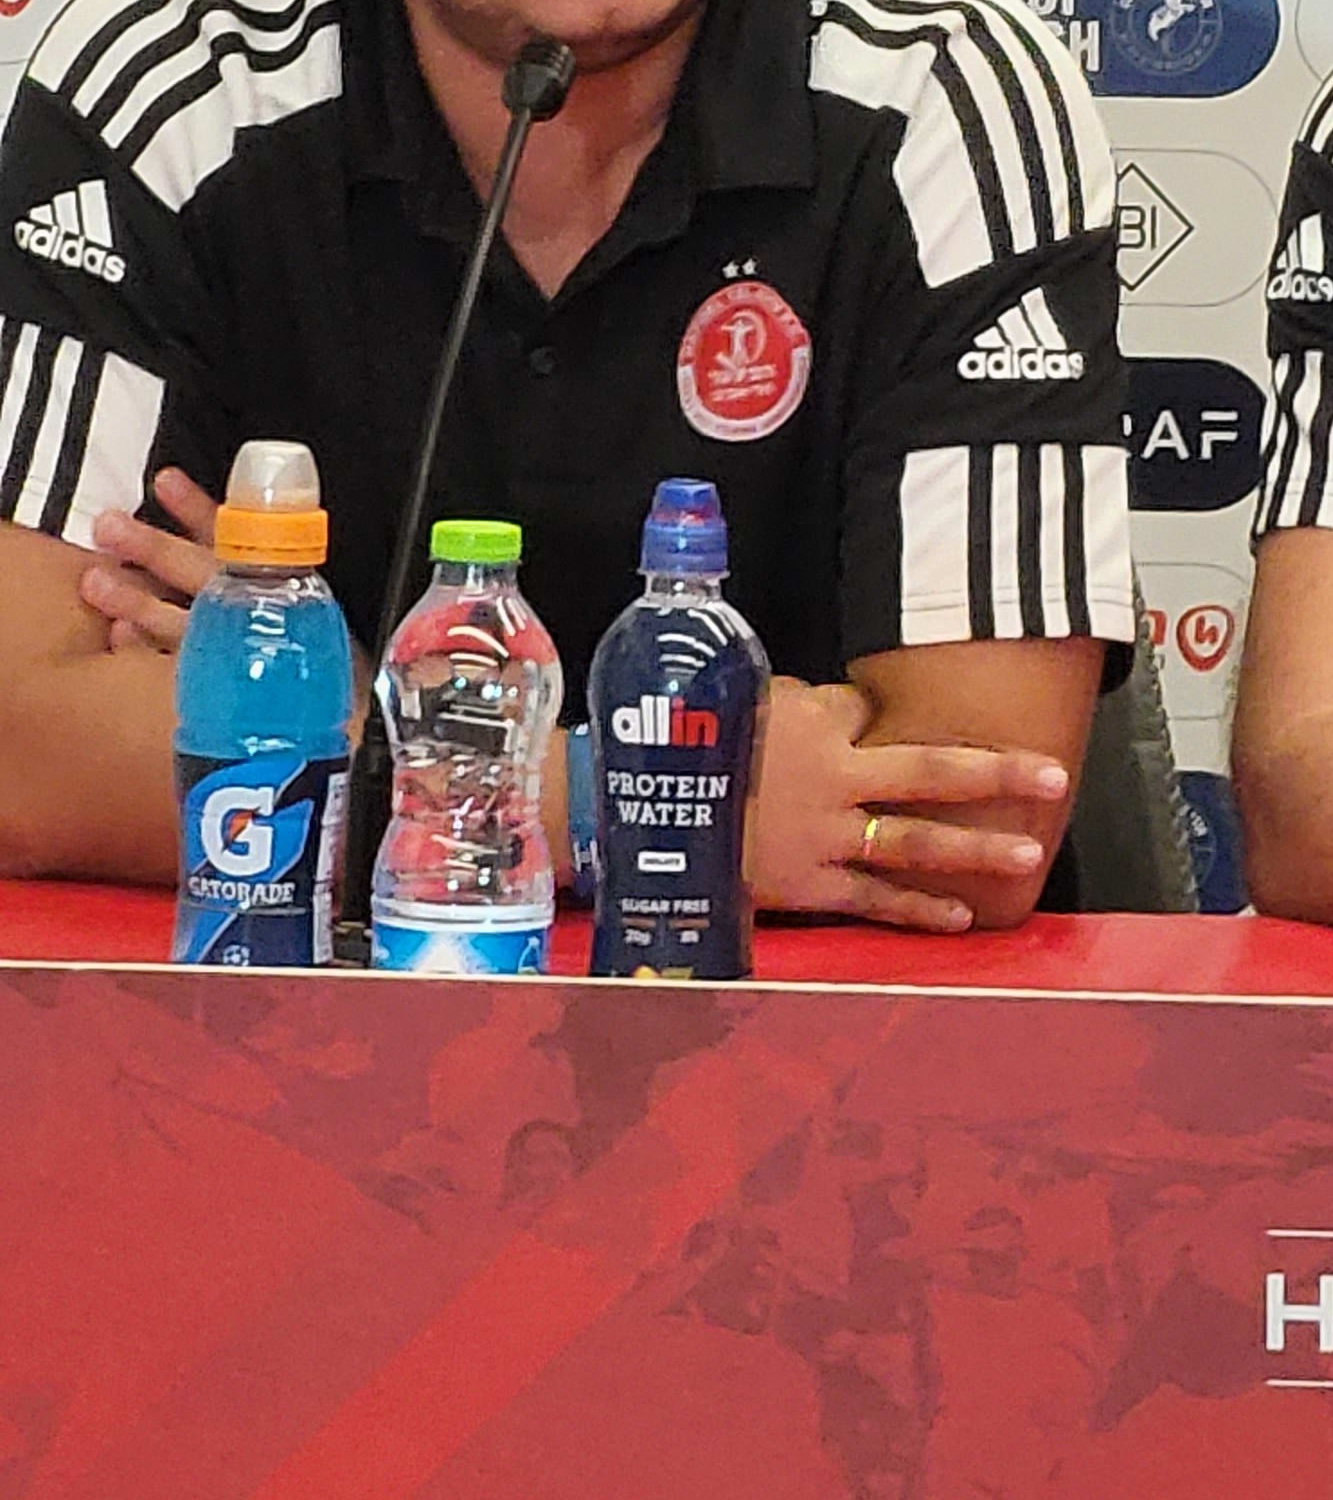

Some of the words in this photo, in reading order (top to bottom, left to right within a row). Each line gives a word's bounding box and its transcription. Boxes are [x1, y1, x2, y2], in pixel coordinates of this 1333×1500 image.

[10, 216, 130, 274] adidas
[958, 342, 1083, 379] adidas
[612, 692, 719, 746] allin
[608, 771, 729, 802] PROTEIN
[617, 801, 712, 826] WATER
[184, 872, 298, 908] GATORADE
